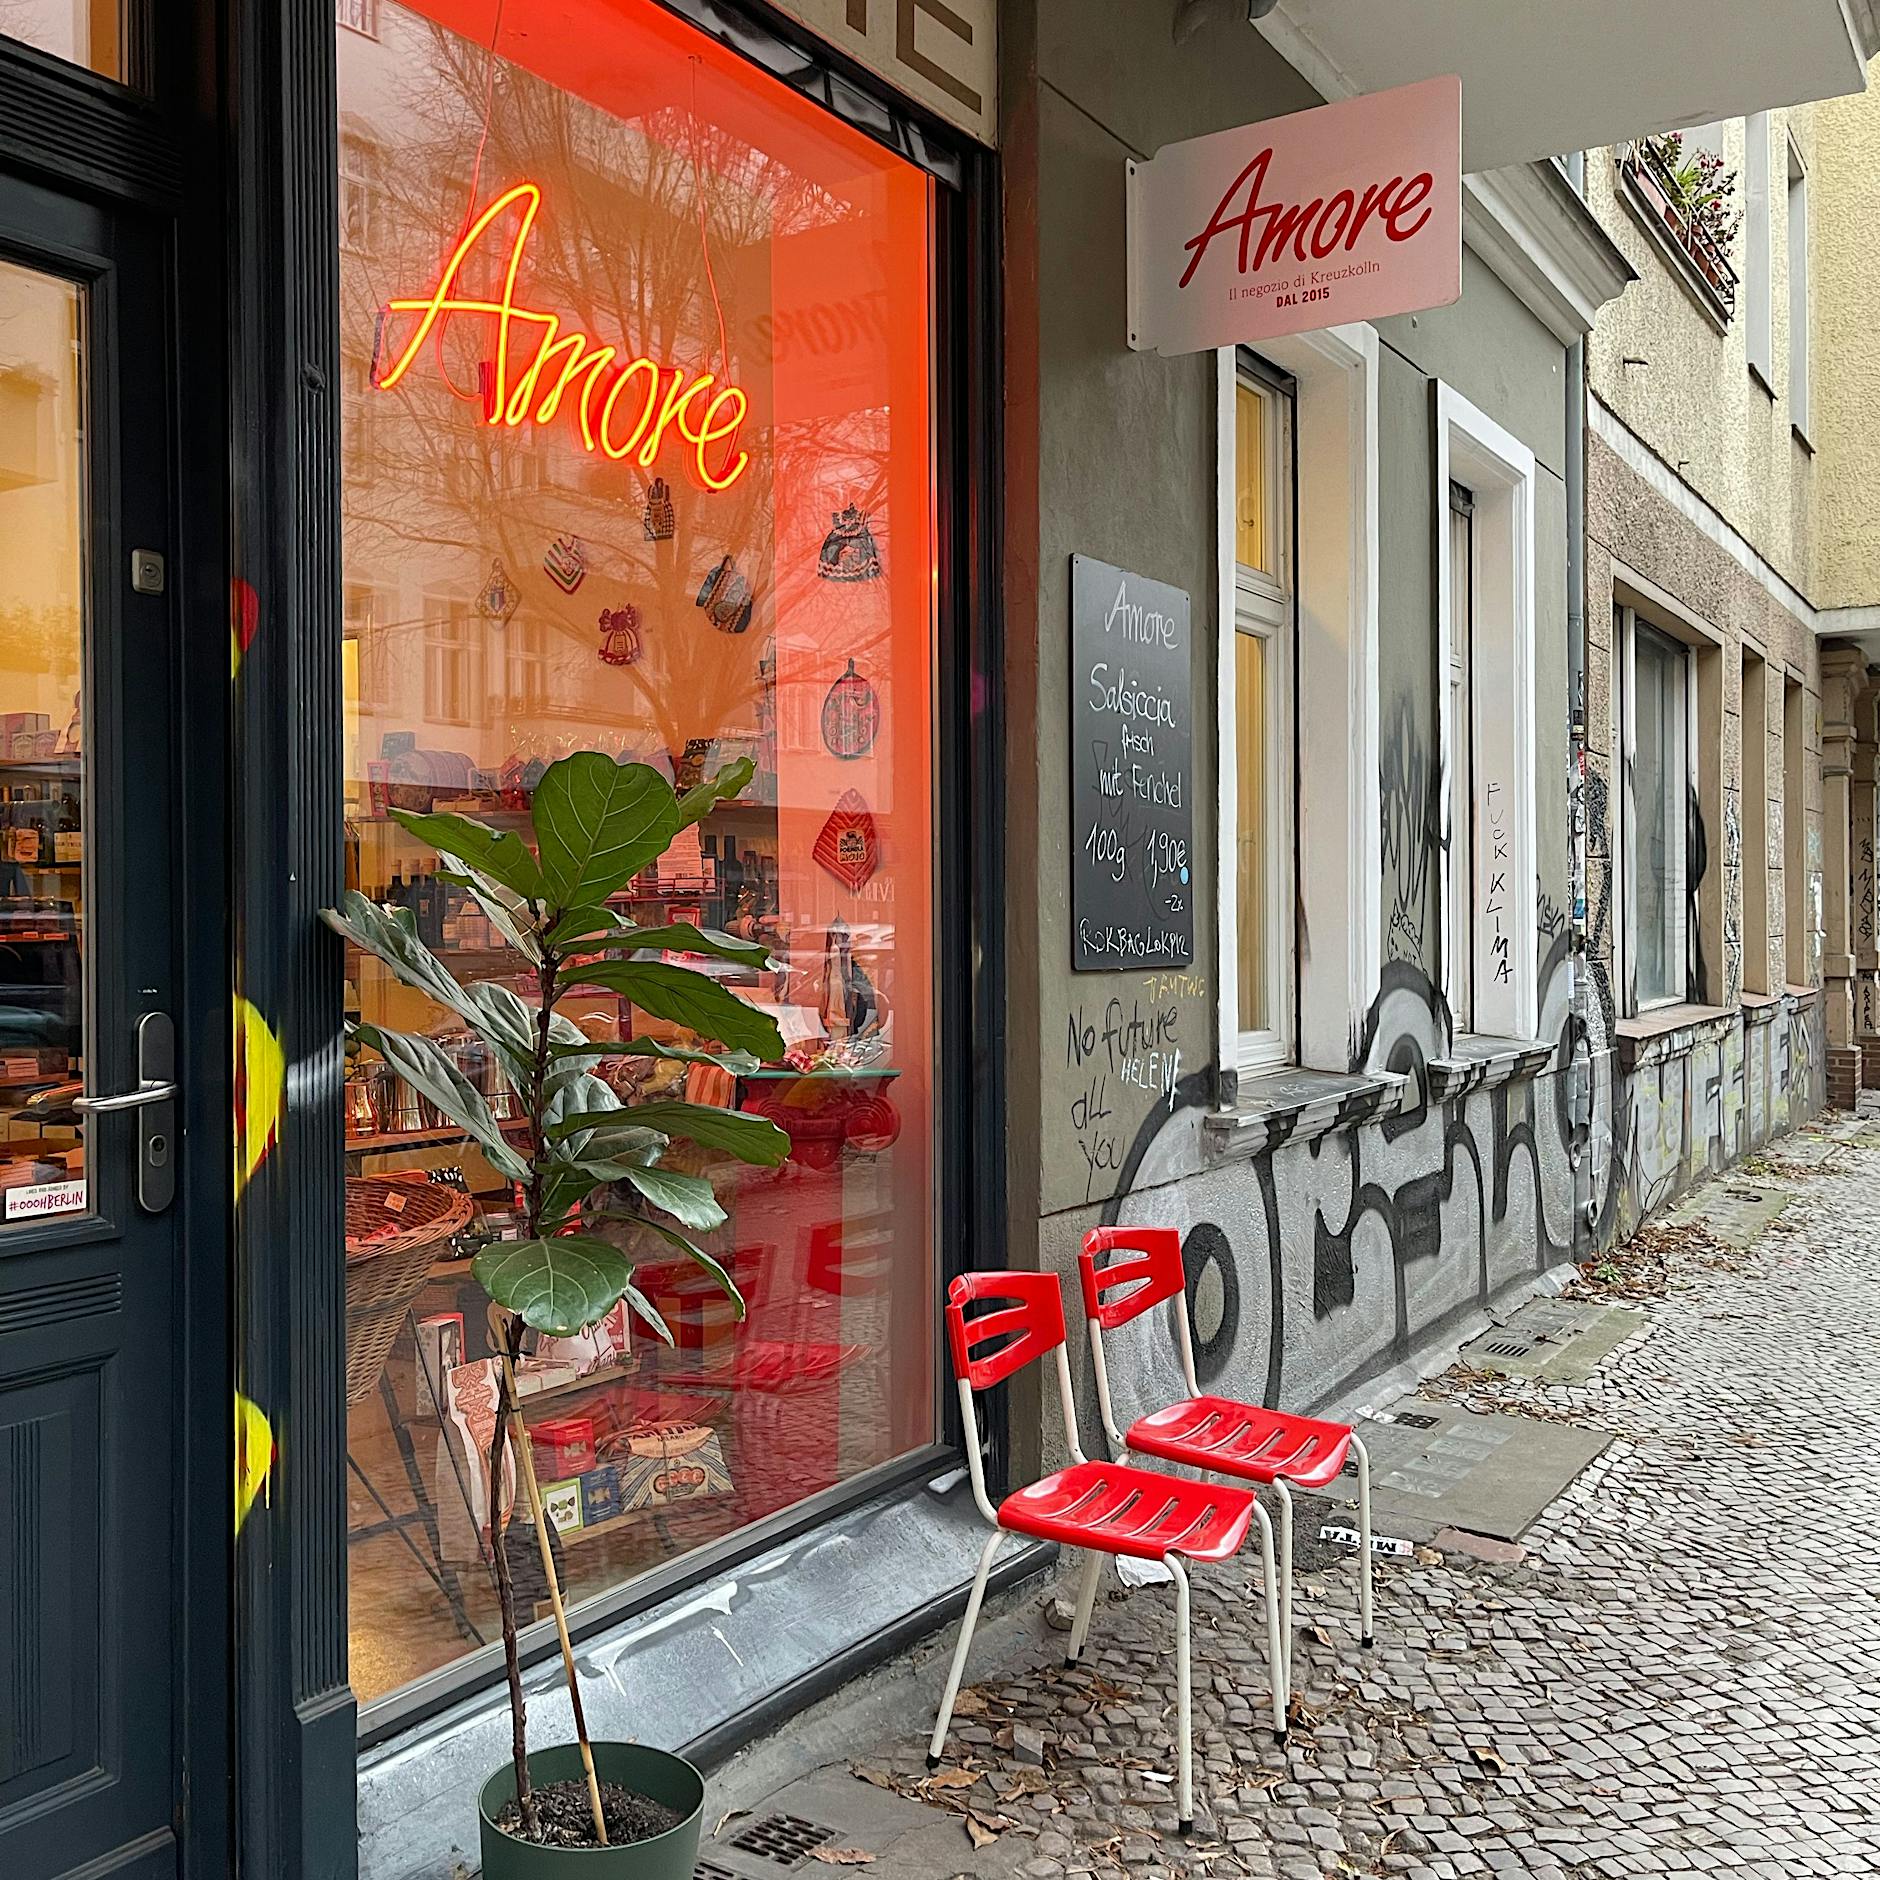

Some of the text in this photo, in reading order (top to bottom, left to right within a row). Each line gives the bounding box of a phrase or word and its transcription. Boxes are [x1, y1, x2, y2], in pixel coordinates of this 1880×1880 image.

[1179, 148, 1433, 288] Amore
[1241, 279, 1289, 298] negozio
[1293, 275, 1305, 287] di
[1276, 287, 1330, 308] DAL 2015
[379, 183, 749, 490] Amore
[1104, 580, 1180, 650] Amore
[1089, 663, 1176, 728] Salsiccia
[1121, 723, 1155, 760] frisch
[1099, 757, 1182, 808] mit Fenchel
[1085, 821, 1126, 883] 100g
[1486, 783, 1514, 984] FUCK KLIMA
[1066, 998, 1178, 1074] No future
